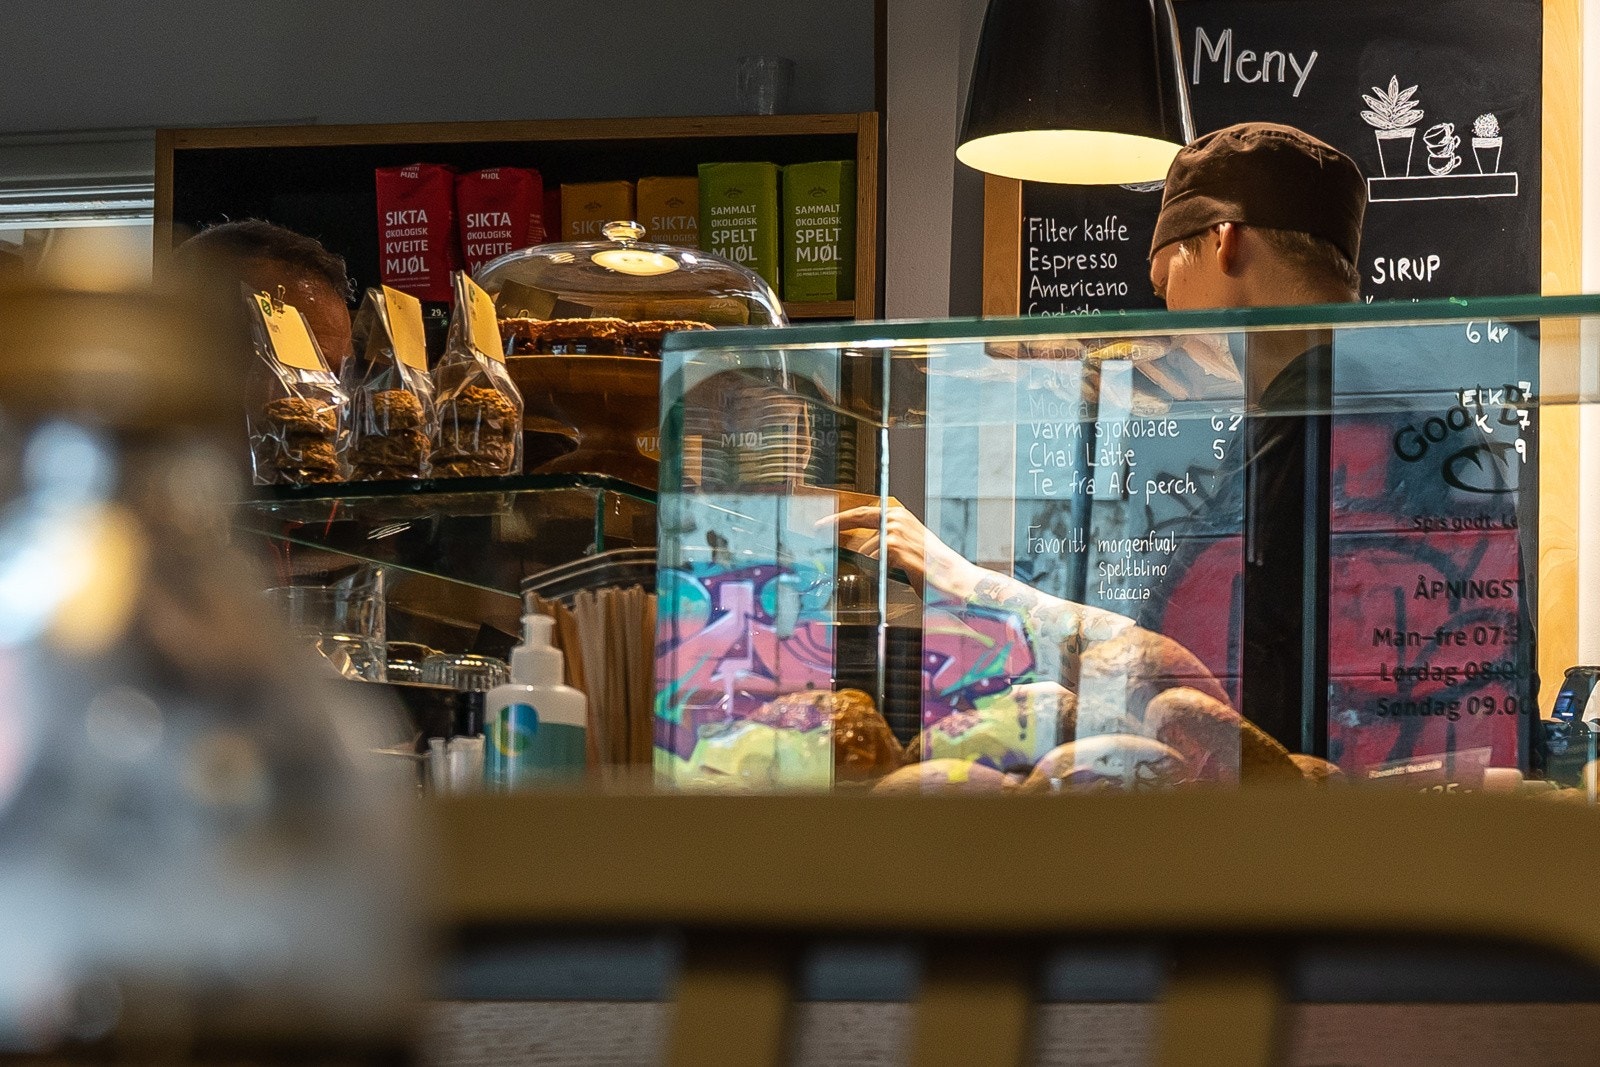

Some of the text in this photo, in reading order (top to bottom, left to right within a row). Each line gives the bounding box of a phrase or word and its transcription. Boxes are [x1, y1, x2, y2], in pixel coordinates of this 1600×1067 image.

[1193, 26, 1318, 97] Meny
[386, 209, 428, 227] SIKTA
[711, 205, 757, 216] SAMMALT
[795, 204, 841, 215] SAMMALT
[467, 212, 512, 228] SIKTA
[572, 219, 612, 236] SIKT
[651, 215, 698, 231] SIKTA
[711, 217, 758, 228] ØKOLOGISK
[795, 216, 842, 227] ØKOLOGISK
[1029, 215, 1130, 243] Filter kaffe
[386, 227, 429, 239] ØKOLOGISK
[467, 230, 512, 241] ØKOLOGISK
[711, 228, 758, 245] SPELT
[795, 228, 842, 244] SPELT
[386, 239, 429, 254] KVEITE
[467, 242, 513, 257] KVEITE
[712, 244, 758, 263] MJØL
[796, 244, 842, 263] MJØL
[386, 255, 430, 275] MJØL
[1029, 247, 1118, 278] Espresso
[1372, 254, 1441, 285] SIRUP
[1029, 275, 1128, 299] Americano
[721, 430, 768, 449] MJØL
[1094, 417, 1180, 447] sjokolade
[1029, 442, 1075, 468] Chai
[1086, 442, 1138, 467] Latte
[1028, 469, 1058, 496] Te
[1069, 470, 1097, 495] fra
[1146, 472, 1198, 506] perch
[1097, 530, 1178, 559] morgenfugl
